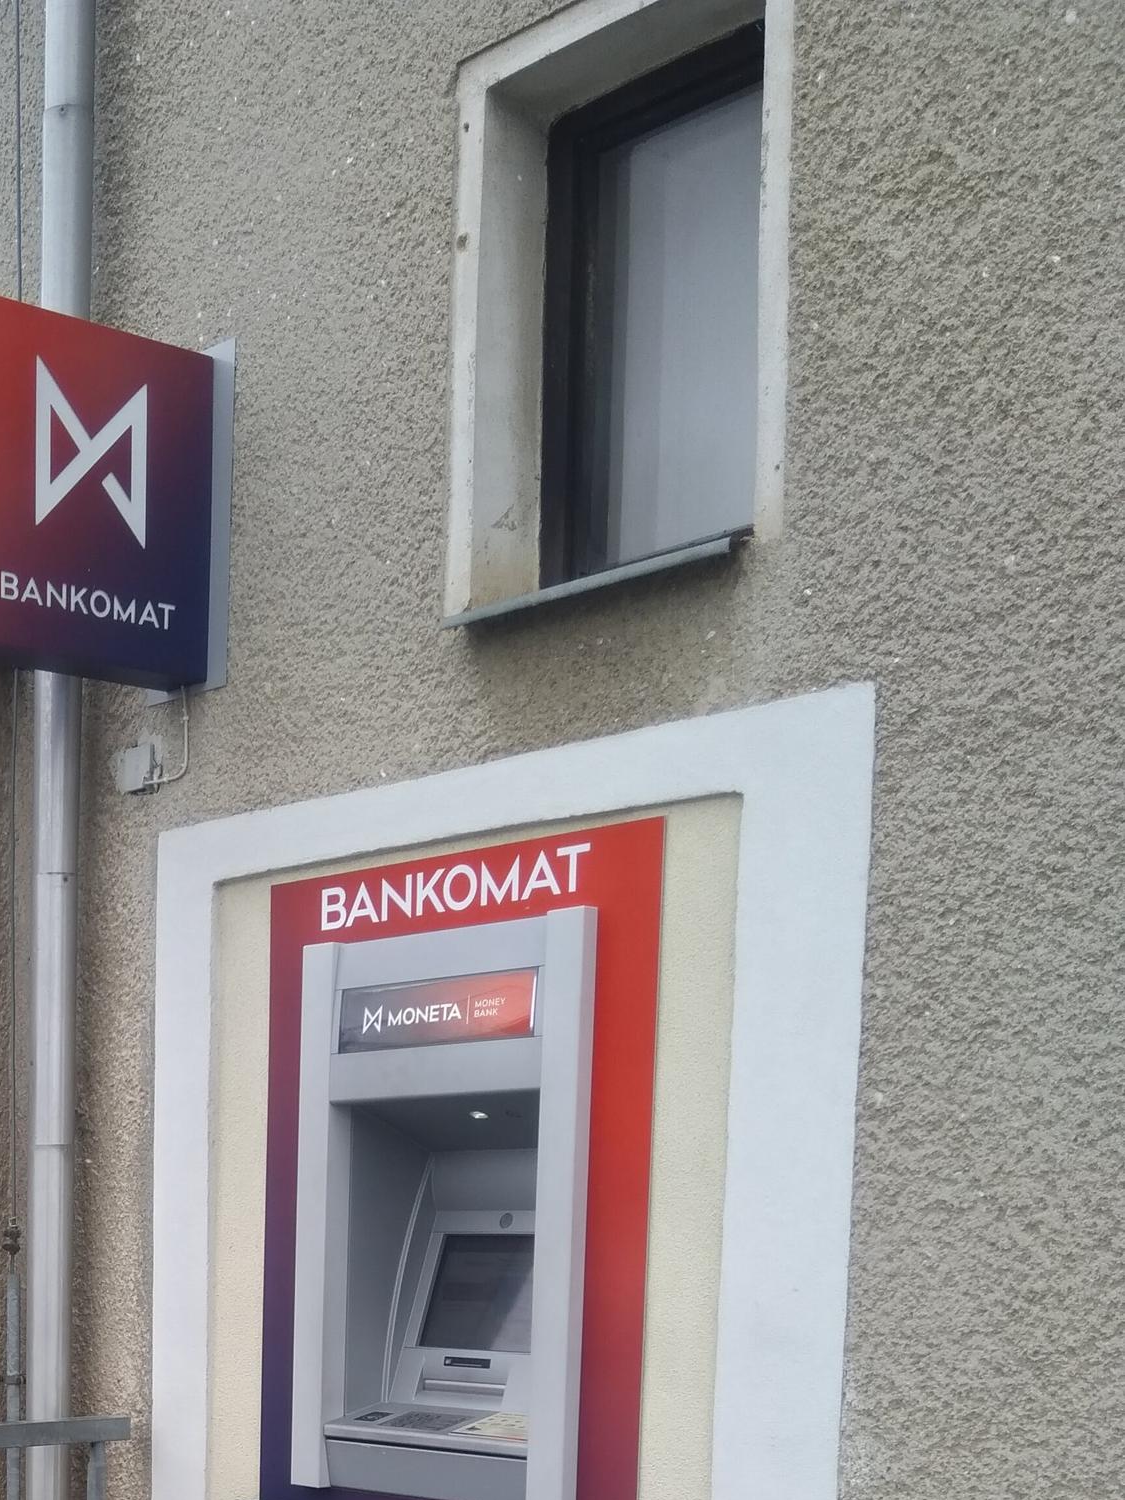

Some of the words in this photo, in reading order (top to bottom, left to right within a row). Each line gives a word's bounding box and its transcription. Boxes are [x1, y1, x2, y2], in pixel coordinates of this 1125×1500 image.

[0, 570, 176, 631] BANKOMAT
[321, 842, 592, 932] BANKOMAT
[474, 997, 506, 1008] MONEY
[474, 1008, 499, 1018] BANK
[387, 1003, 462, 1027] MONETA
